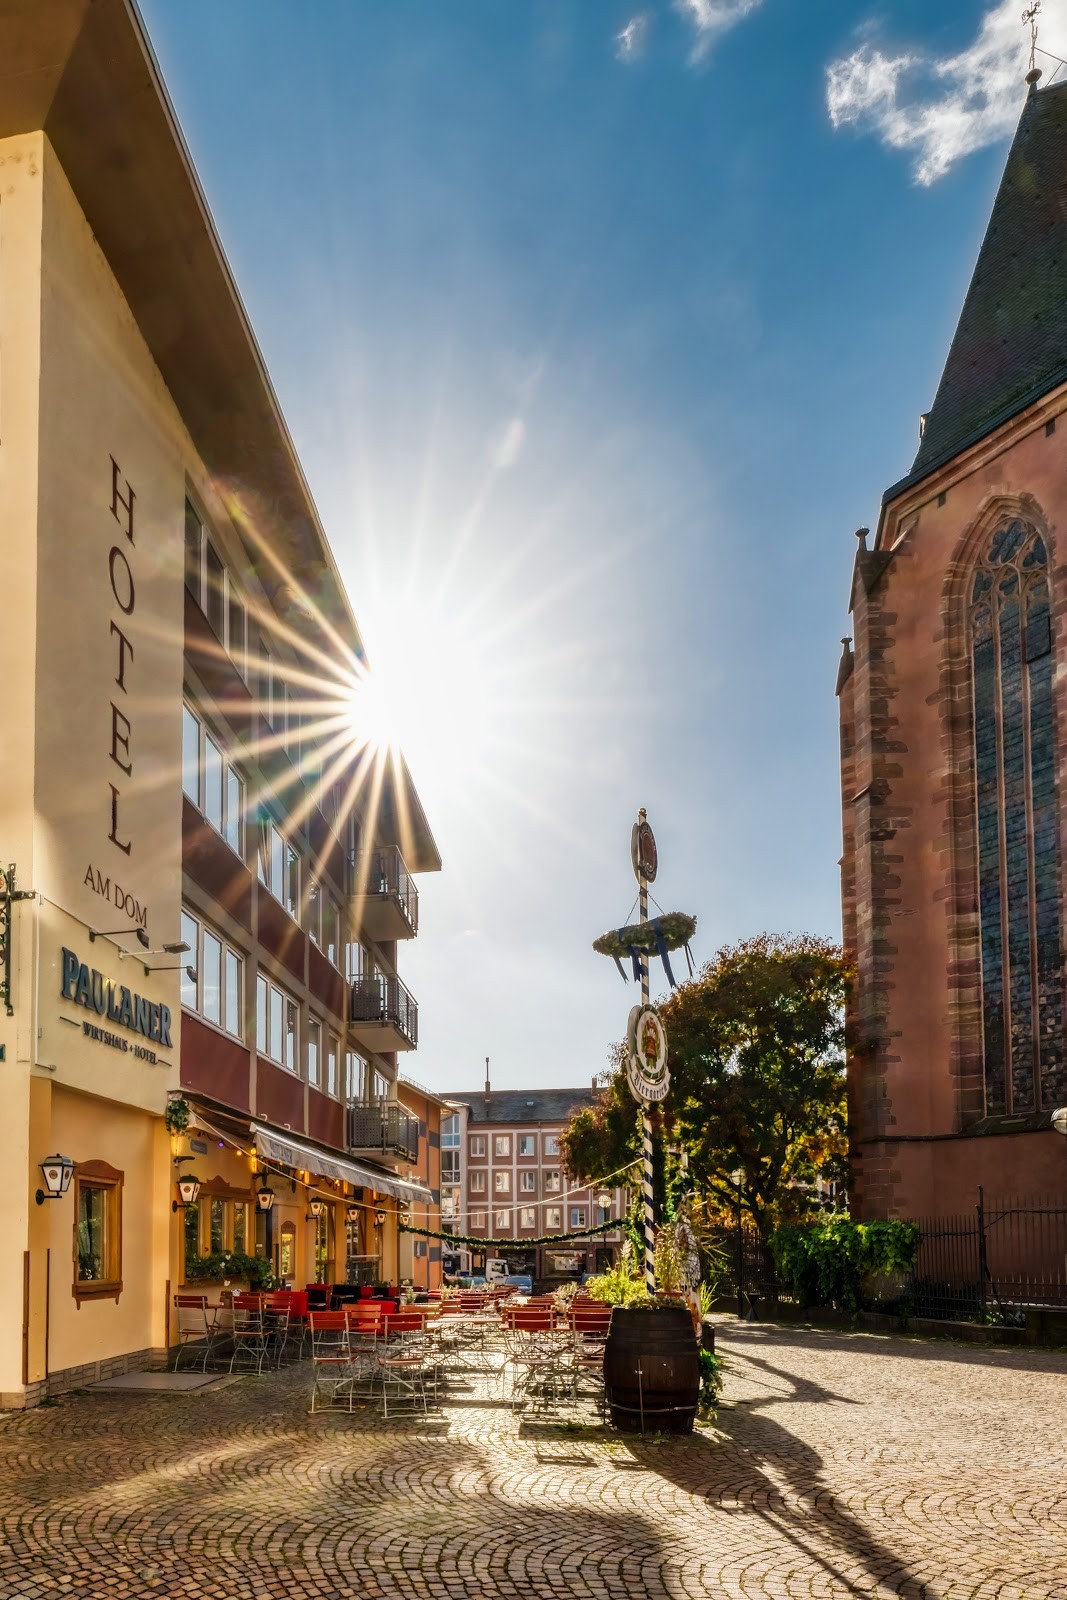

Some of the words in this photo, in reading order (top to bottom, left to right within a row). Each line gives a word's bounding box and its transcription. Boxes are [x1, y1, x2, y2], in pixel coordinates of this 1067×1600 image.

[108, 454, 136, 856] HOTEL
[84, 864, 111, 901] AM
[114, 884, 148, 928] DOM
[62, 947, 173, 1049] PAULANER
[82, 1020, 128, 1052] WIRTSHAUS
[134, 1044, 158, 1065] HOTEL
